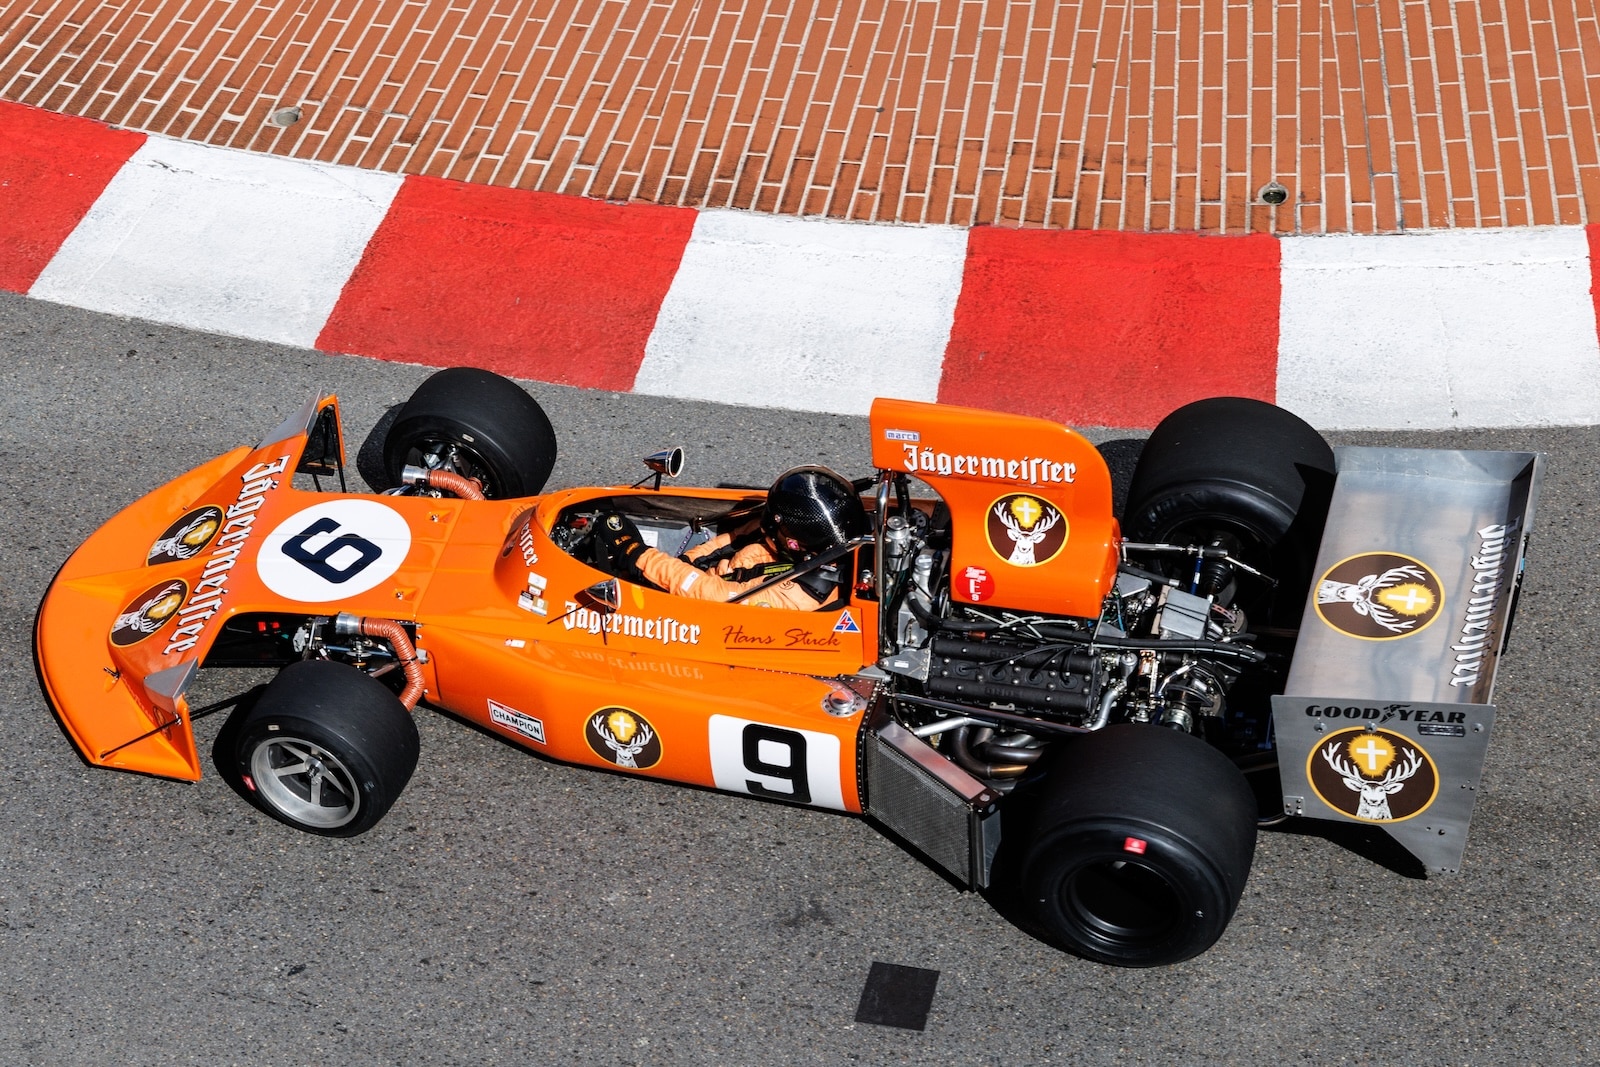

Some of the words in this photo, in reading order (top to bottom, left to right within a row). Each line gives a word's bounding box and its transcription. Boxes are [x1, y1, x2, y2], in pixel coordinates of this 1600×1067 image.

[887, 431, 919, 441] march
[903, 443, 1077, 485] Jägermeister
[162, 454, 291, 656] Jägermeister
[722, 625, 776, 645] Hans
[784, 627, 841, 648] Stuck
[492, 709, 540, 735] CHAMPION
[742, 723, 812, 804] 9
